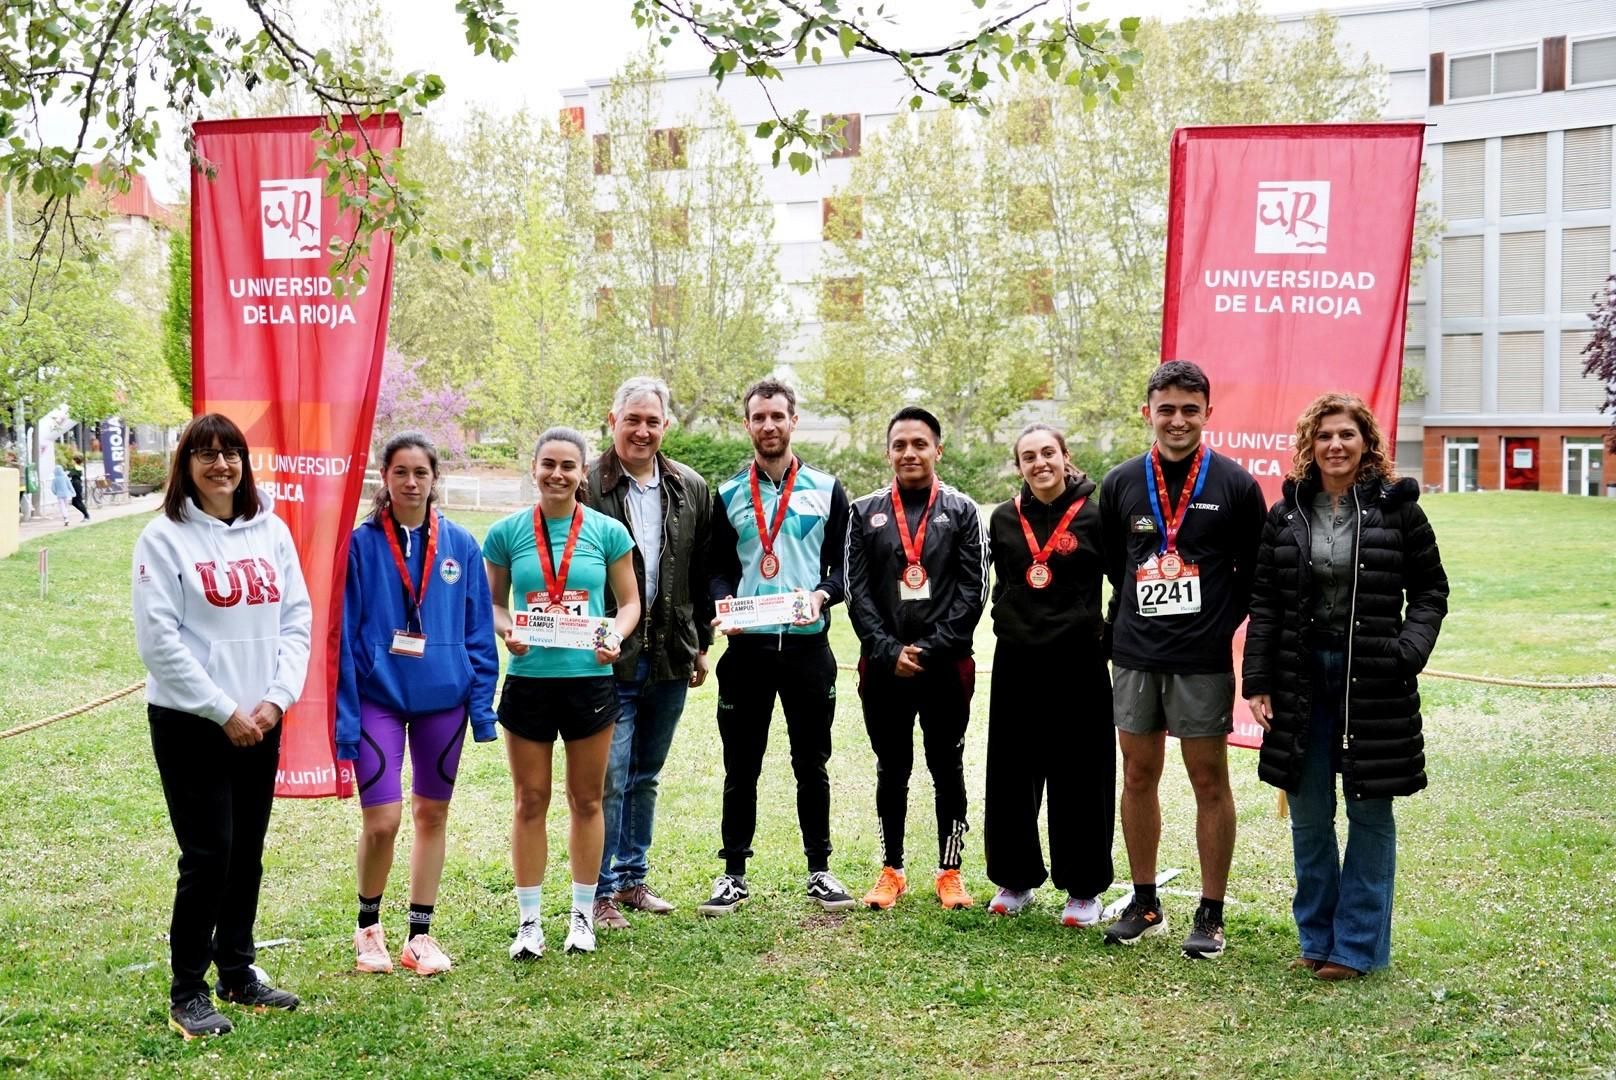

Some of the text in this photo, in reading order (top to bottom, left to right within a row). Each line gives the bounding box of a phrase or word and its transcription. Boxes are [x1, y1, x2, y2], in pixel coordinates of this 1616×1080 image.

[229, 277, 368, 298] UNIVERSID
[1204, 270, 1376, 290] UNIVERSIDAD
[243, 304, 357, 329] DE LA RIOJA
[1215, 294, 1362, 319] DE LA RIOJA
[107, 416, 125, 461] RIOJA
[1201, 430, 1297, 451] TU UNIVER
[250, 453, 353, 477] U UNIVERSID
[1195, 502, 1220, 511] TERREX
[195, 557, 282, 608] UR
[730, 599, 754, 607] CARRERA
[1140, 580, 1193, 607] 2241
[730, 605, 755, 613] CAMPUS
[528, 620, 554, 629] CAMPUS
